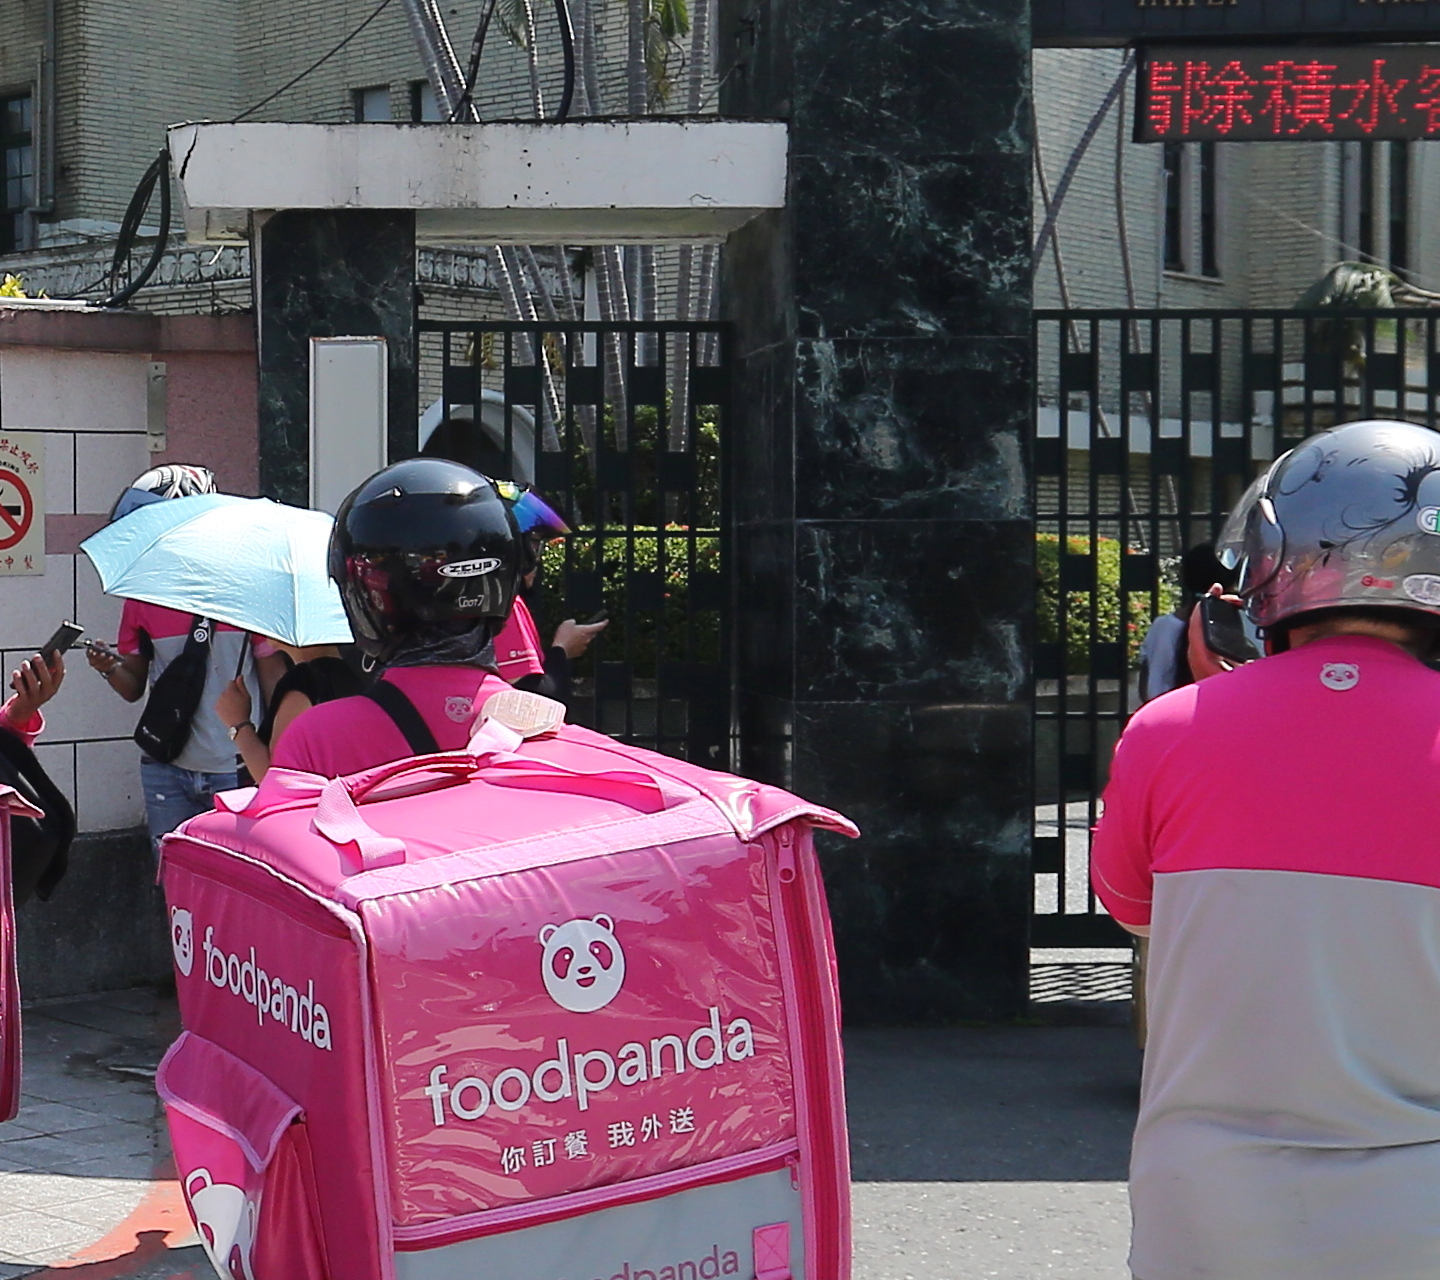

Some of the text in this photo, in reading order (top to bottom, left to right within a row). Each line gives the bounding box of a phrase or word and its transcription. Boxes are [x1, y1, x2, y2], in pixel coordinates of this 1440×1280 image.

[203, 926, 332, 1051] foodpanda
[425, 1006, 755, 1126] foodpanda
[501, 1107, 696, 1175] 你訂餐 我外送
